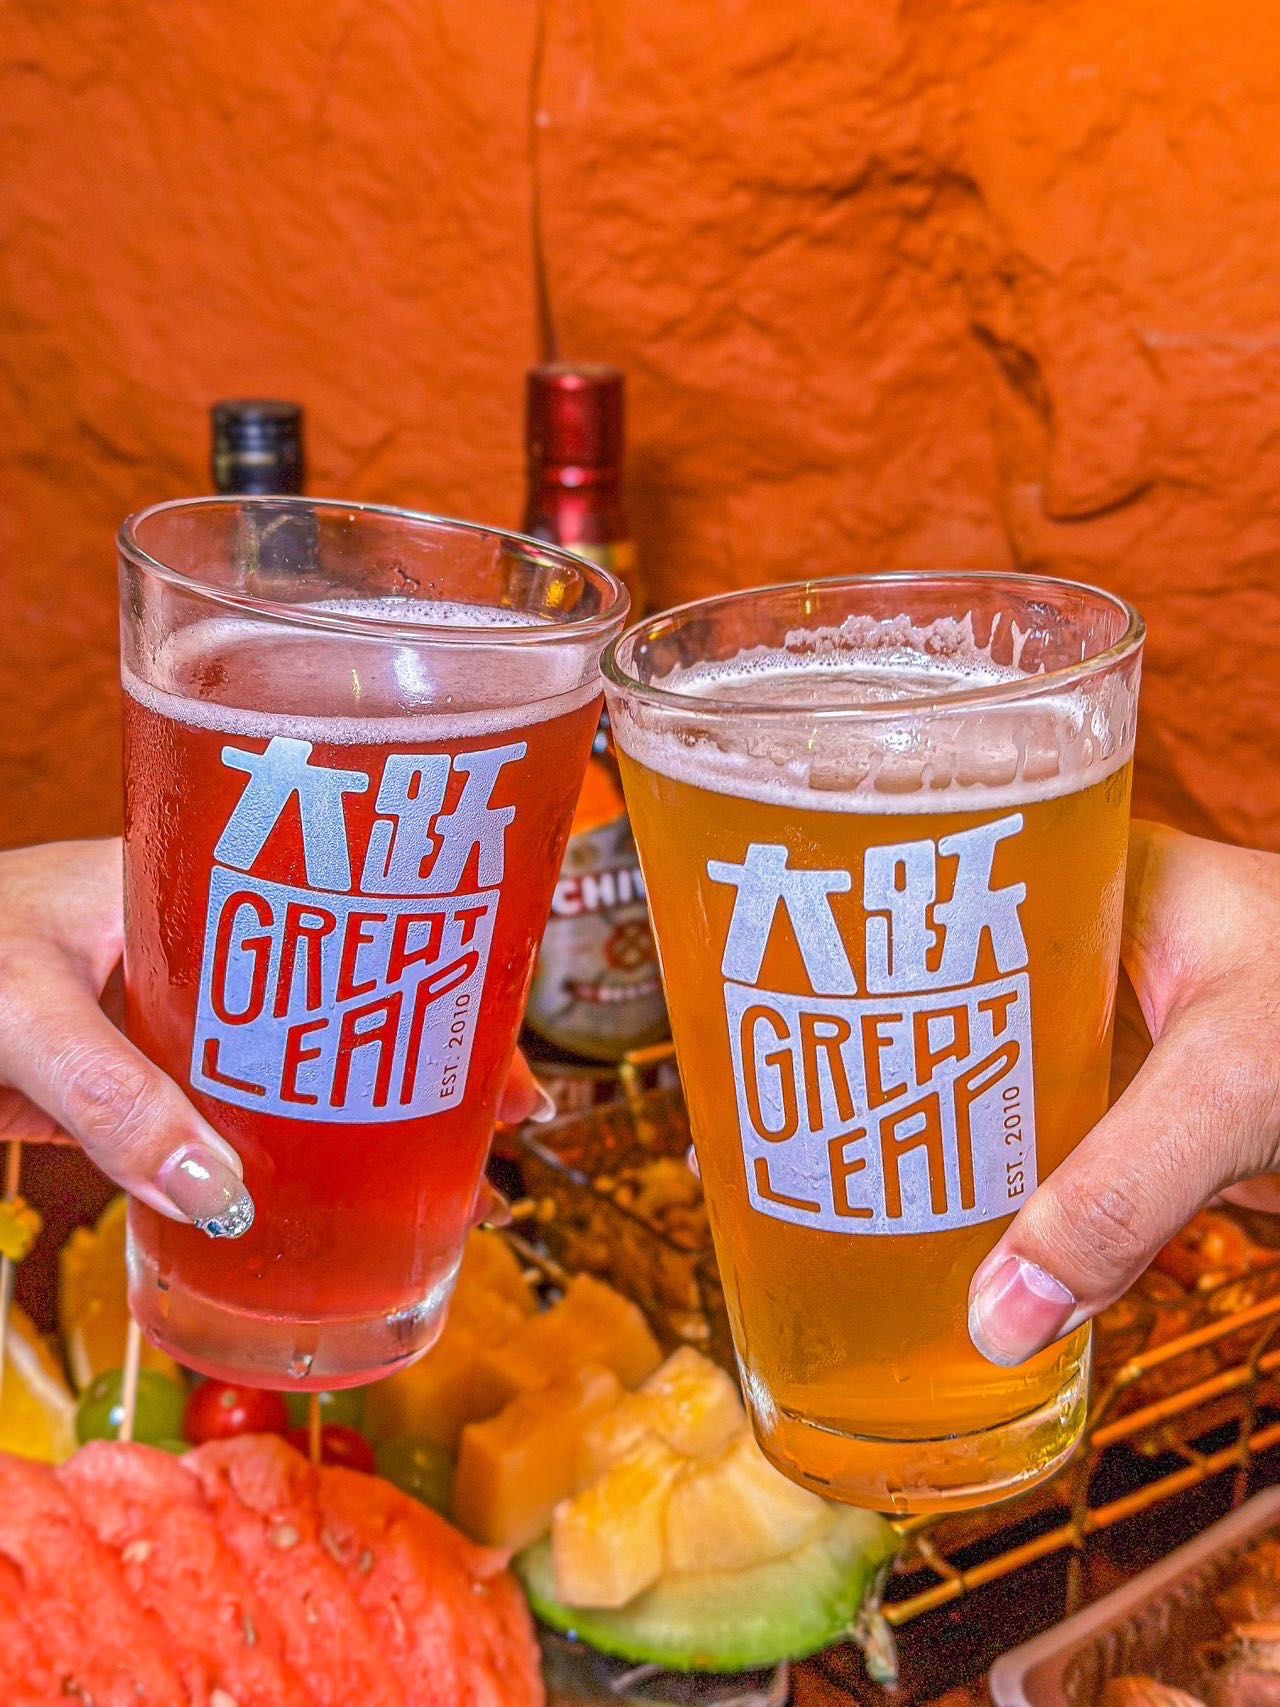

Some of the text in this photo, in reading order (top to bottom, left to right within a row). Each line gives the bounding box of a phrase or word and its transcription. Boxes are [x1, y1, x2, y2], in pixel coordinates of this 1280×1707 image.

[213, 736, 528, 895] 大跃
[211, 890, 489, 1026] GREAT
[707, 813, 1028, 996] 大跃
[201, 950, 480, 1108] LEAP
[440, 993, 471, 1098] EST. 2010
[740, 990, 1019, 1143] GREAT
[753, 1039, 1021, 1219] LEAP
[1003, 1085, 1025, 1199] EST. 2010
